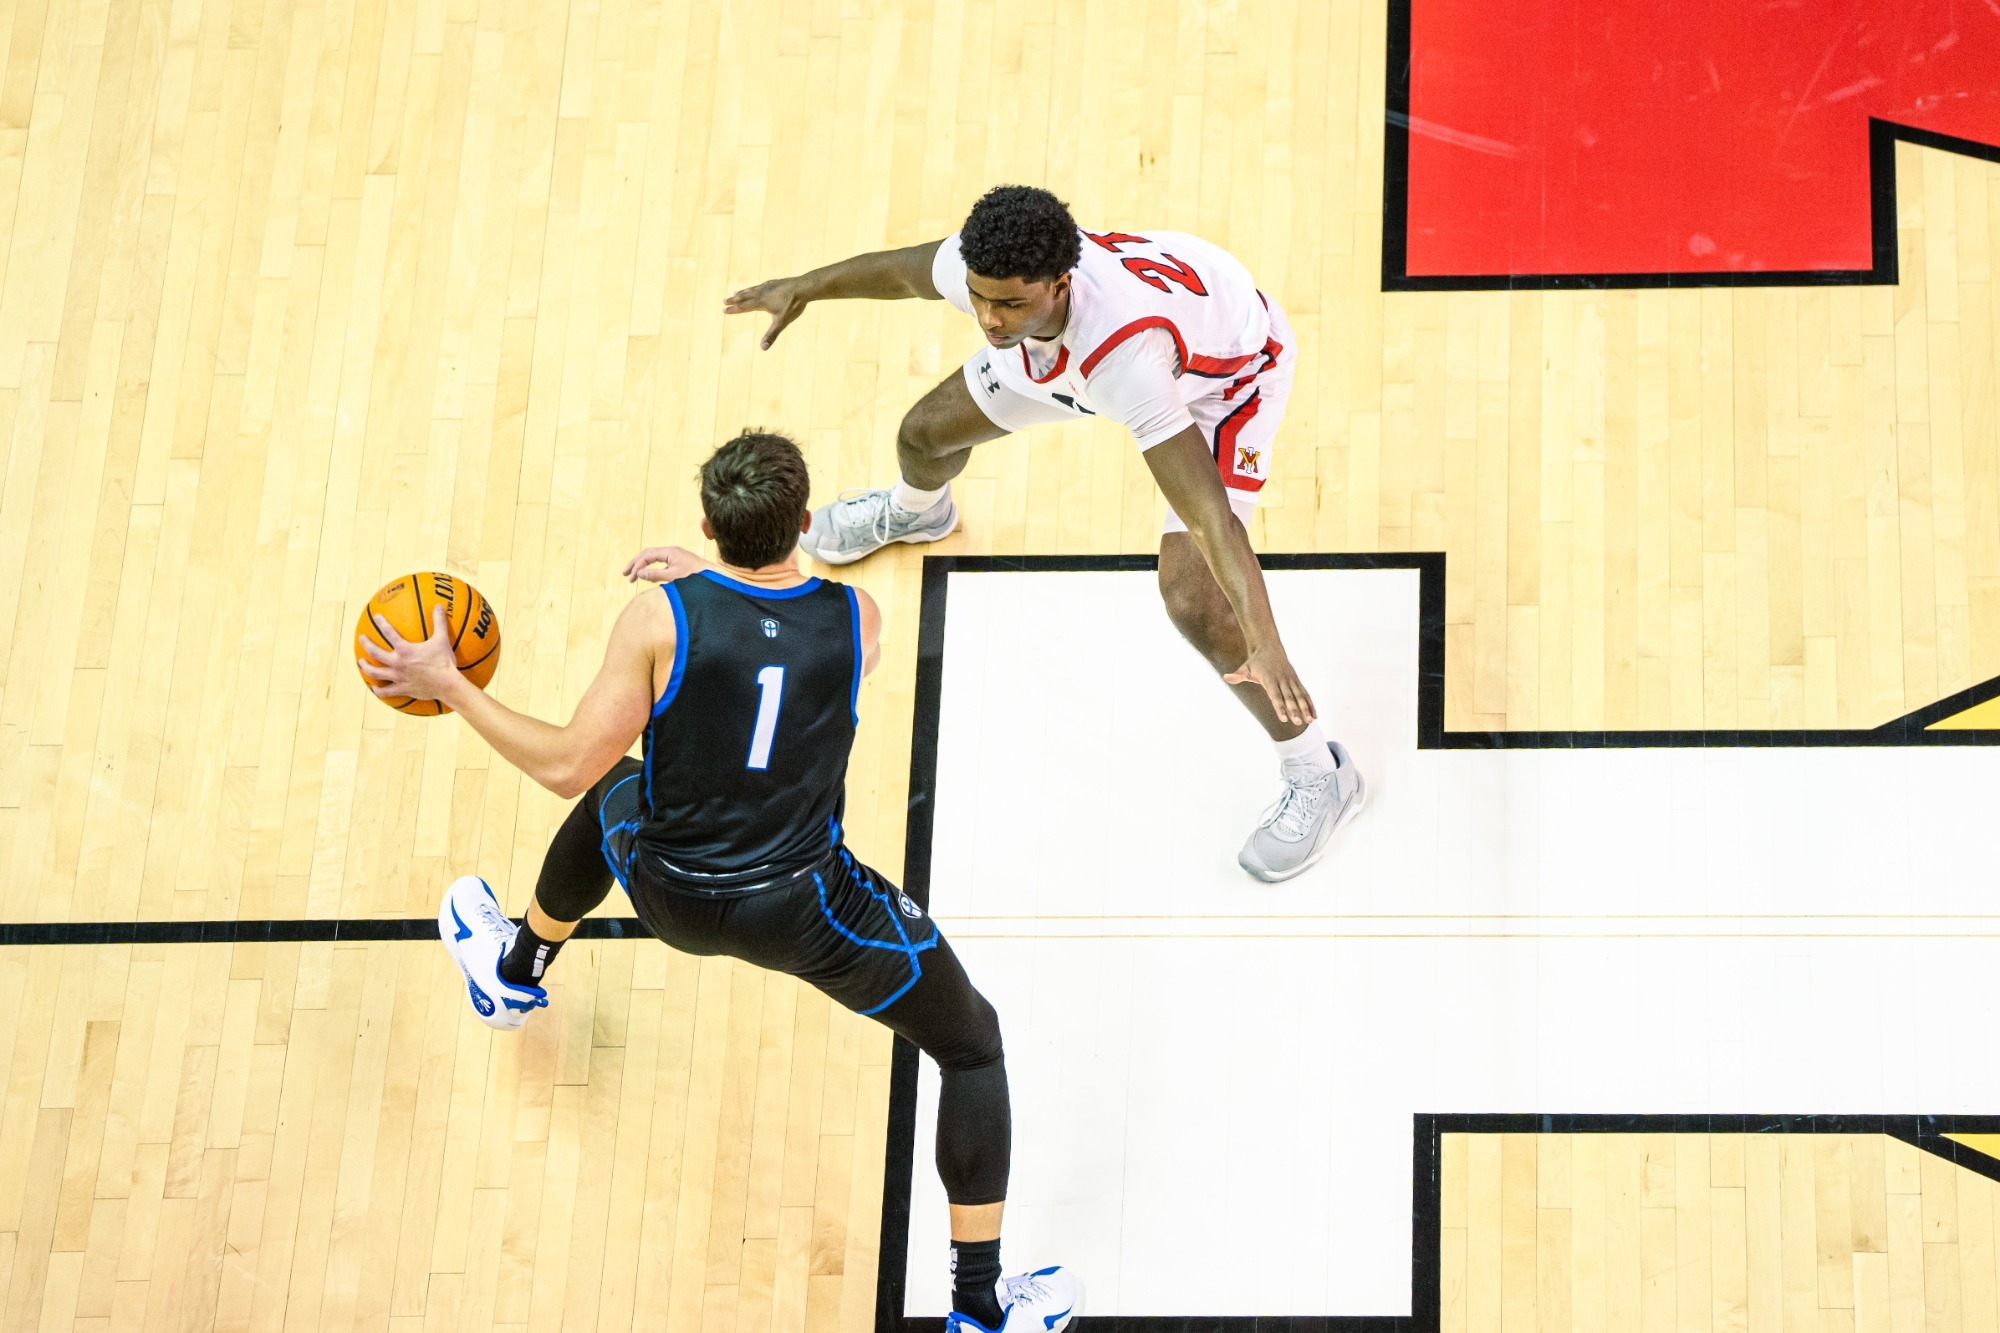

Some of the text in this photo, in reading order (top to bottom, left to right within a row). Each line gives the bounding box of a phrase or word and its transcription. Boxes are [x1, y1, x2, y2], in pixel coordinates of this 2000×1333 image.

[1081, 230, 1209, 296] 21
[432, 572, 454, 601] VO
[746, 663, 786, 771] 1
